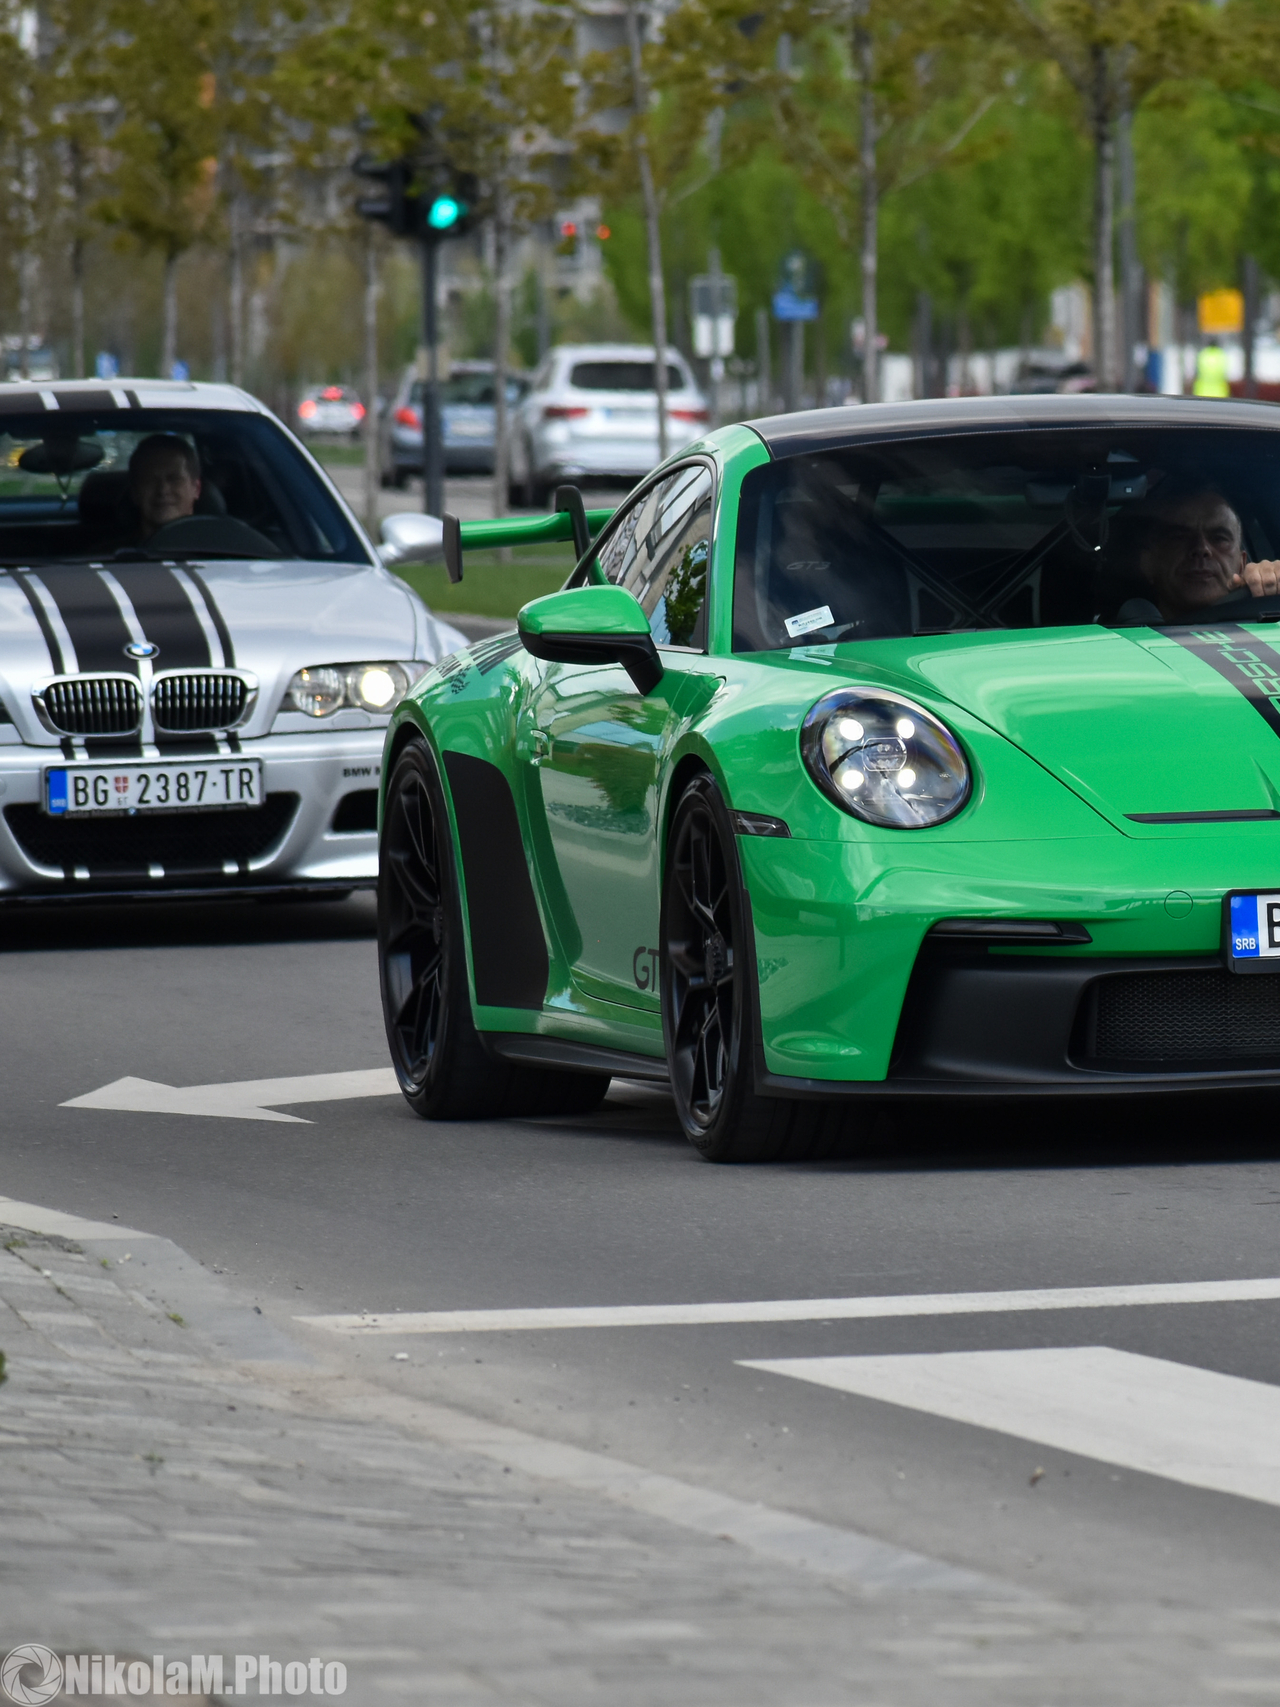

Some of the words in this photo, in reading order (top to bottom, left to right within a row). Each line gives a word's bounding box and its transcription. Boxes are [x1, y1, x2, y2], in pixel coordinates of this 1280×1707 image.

[343, 767, 371, 777] BMW
[73, 775, 109, 807] BG
[1235, 938, 1256, 950] SRB
